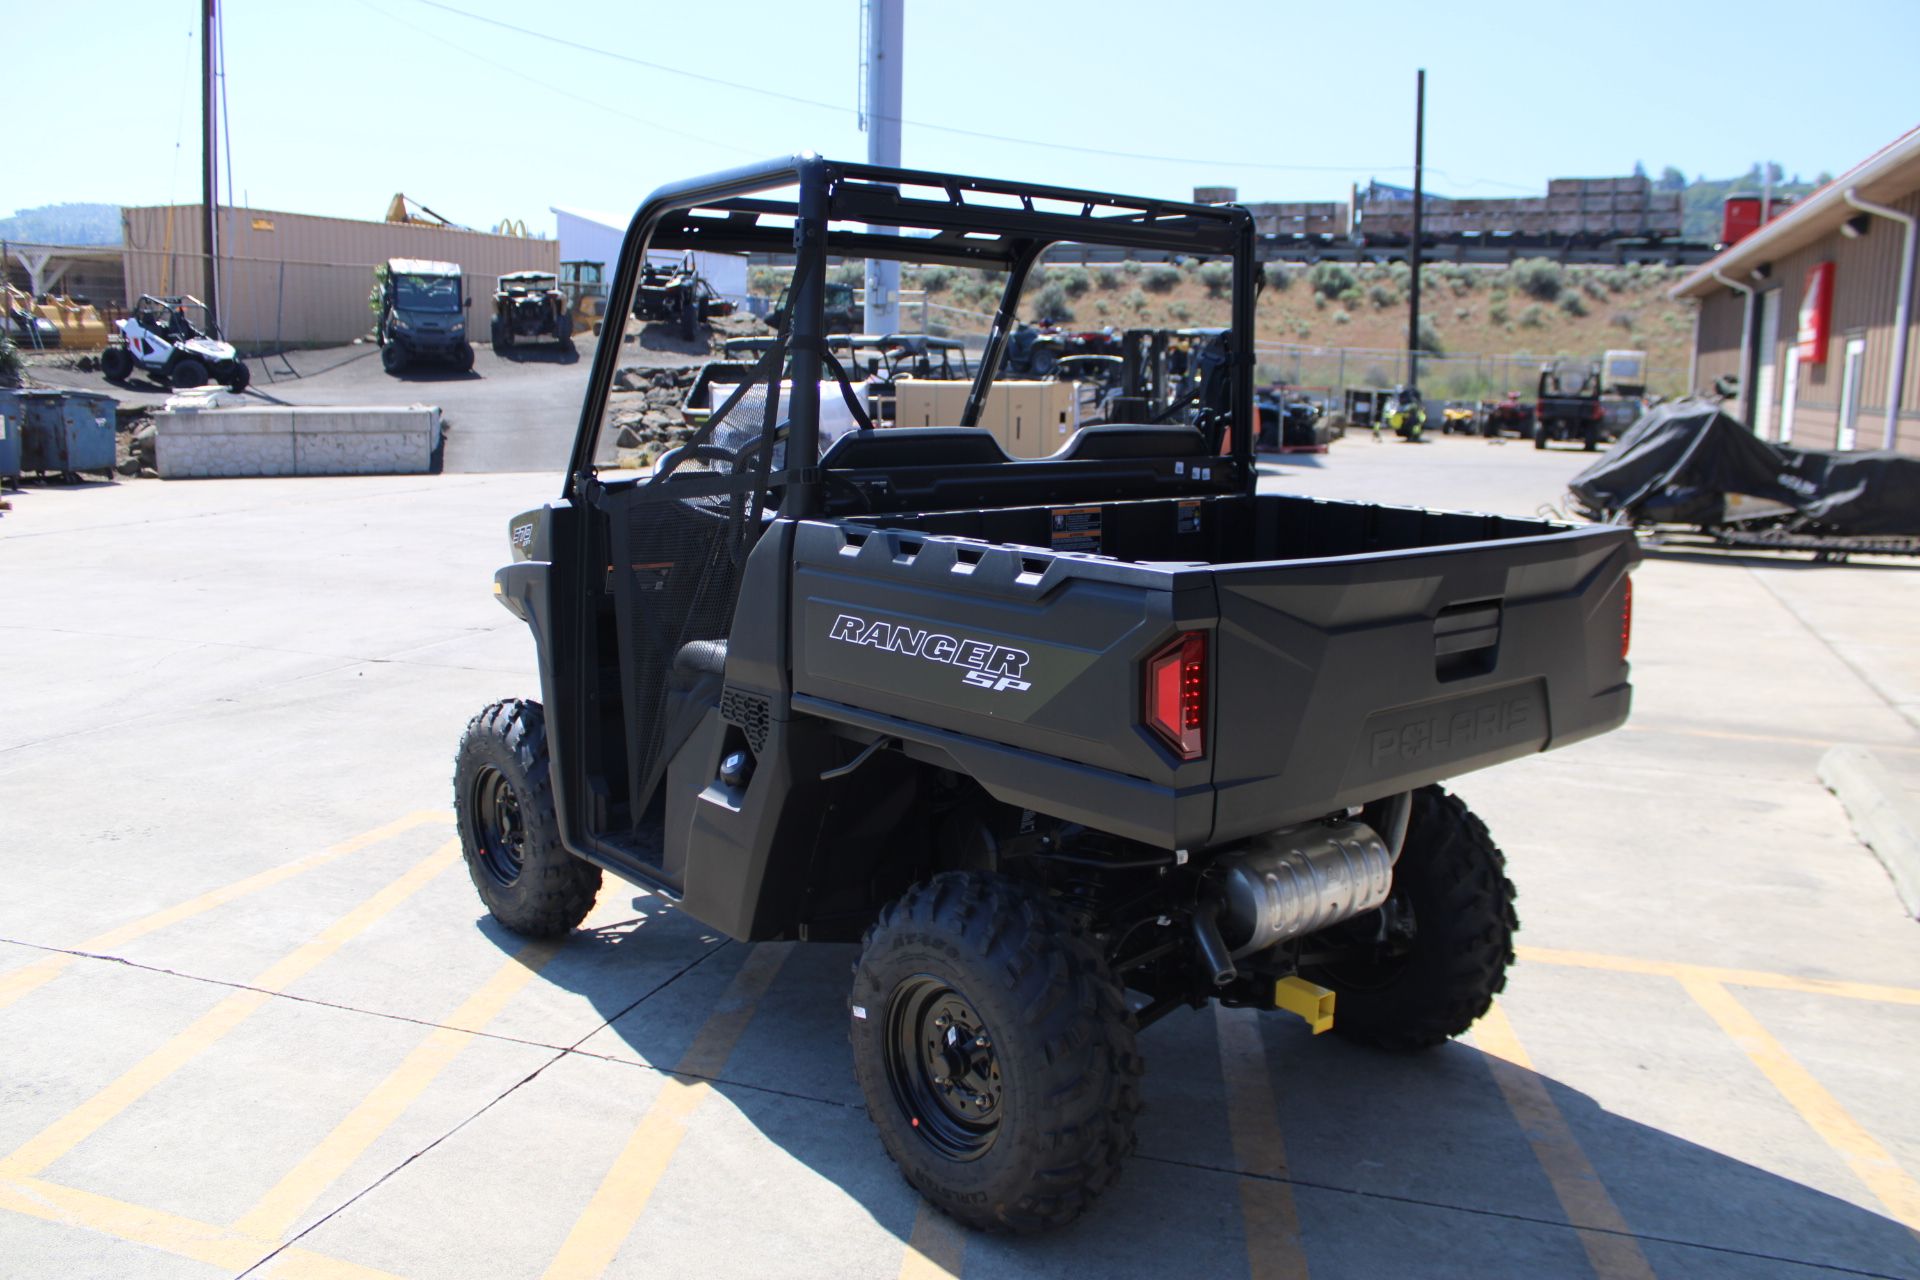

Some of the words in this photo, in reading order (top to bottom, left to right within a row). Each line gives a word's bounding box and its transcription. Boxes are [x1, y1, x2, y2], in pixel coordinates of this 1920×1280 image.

[829, 614, 1030, 678] RANGER
[962, 670, 1031, 691] SP
[1370, 697, 1530, 769] POLARIS
